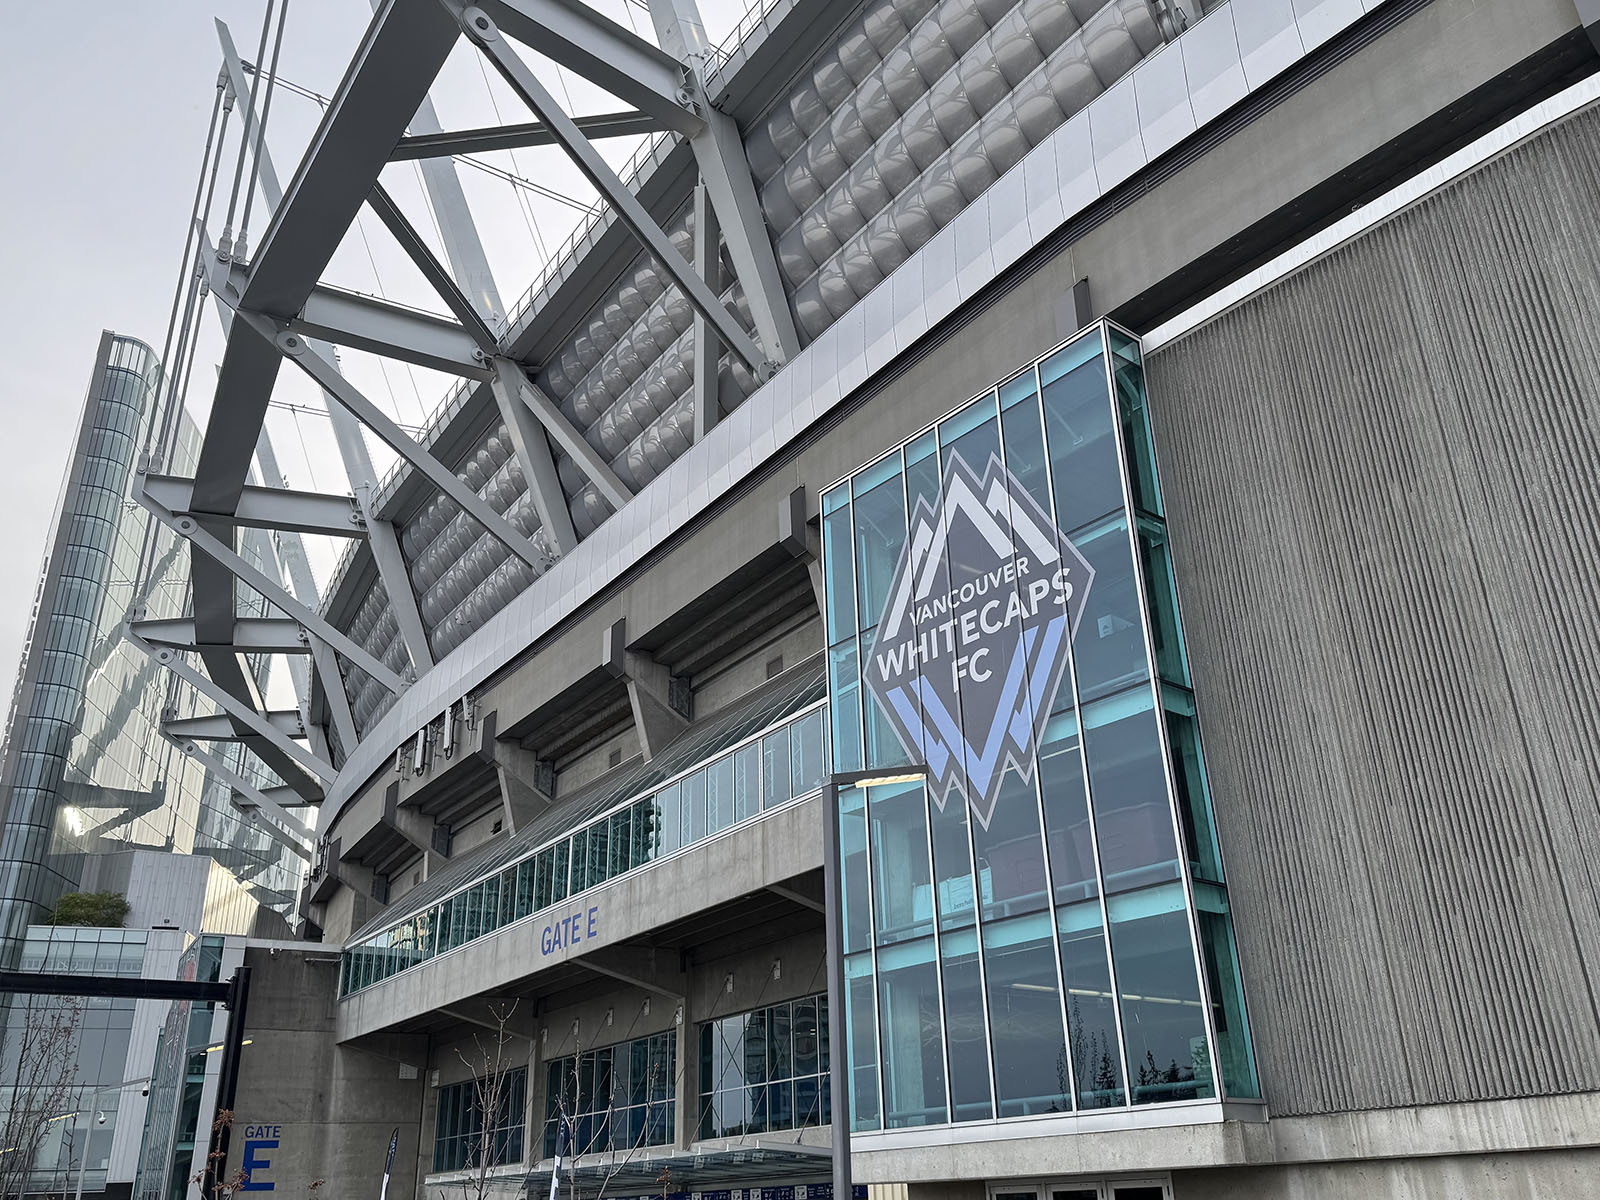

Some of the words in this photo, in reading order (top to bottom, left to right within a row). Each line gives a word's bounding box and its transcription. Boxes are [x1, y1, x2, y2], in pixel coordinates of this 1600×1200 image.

[909, 557, 1030, 627] VANCOUVER
[876, 567, 1074, 682] WHITECAPS
[951, 647, 993, 693] FC
[541, 912, 582, 956] GATE
[587, 906, 598, 939] E
[244, 1125, 282, 1138] GATE
[240, 1140, 280, 1192] E
